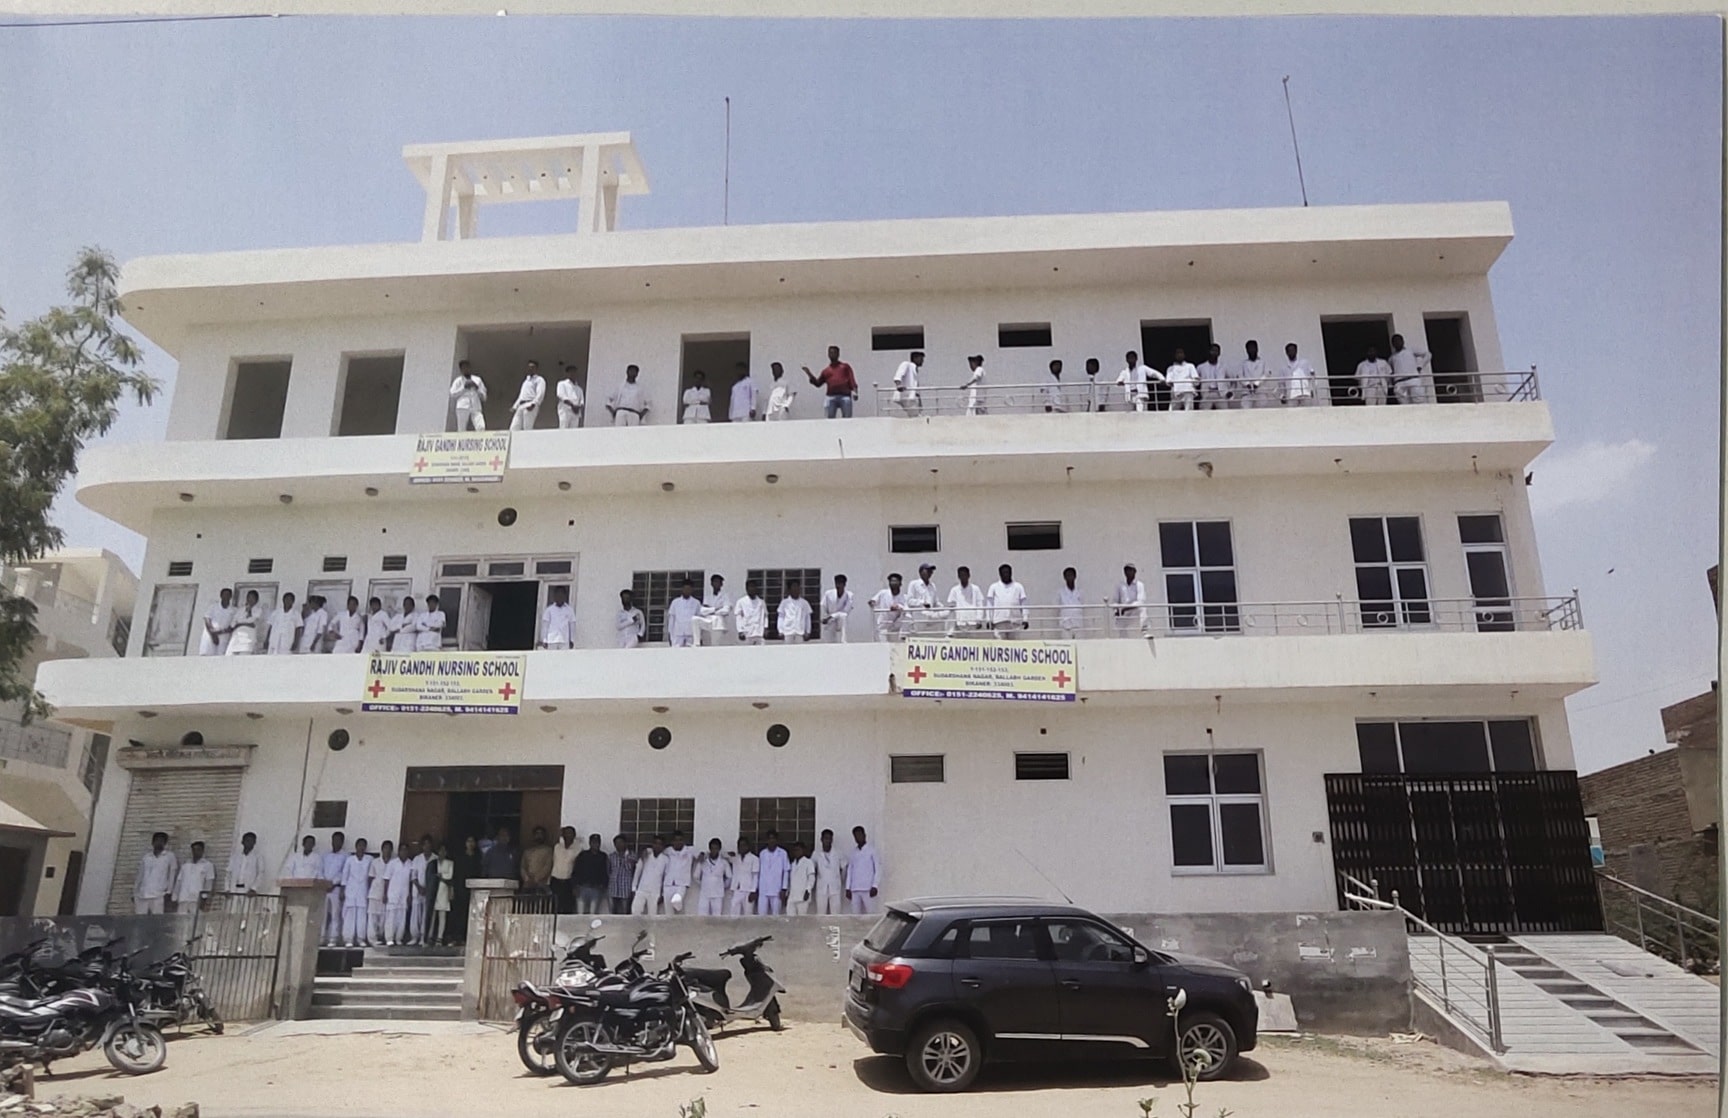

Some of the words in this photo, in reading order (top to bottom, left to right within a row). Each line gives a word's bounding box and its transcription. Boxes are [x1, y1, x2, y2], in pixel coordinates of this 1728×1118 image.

[416, 439, 434, 452] RAJIV
[434, 439, 457, 452] GANDHI
[457, 439, 484, 451] NURSING
[484, 438, 507, 451] SCHOOL
[907, 645, 938, 661] RAJIV
[940, 646, 979, 662] GANDHI
[983, 647, 1028, 663] NURSING
[1031, 648, 1073, 664] SCHOOL
[370, 659, 398, 675] RAJIV
[400, 660, 435, 675] GANDHI
[437, 660, 480, 676] NURSING
[482, 661, 520, 677] SCHOOL
